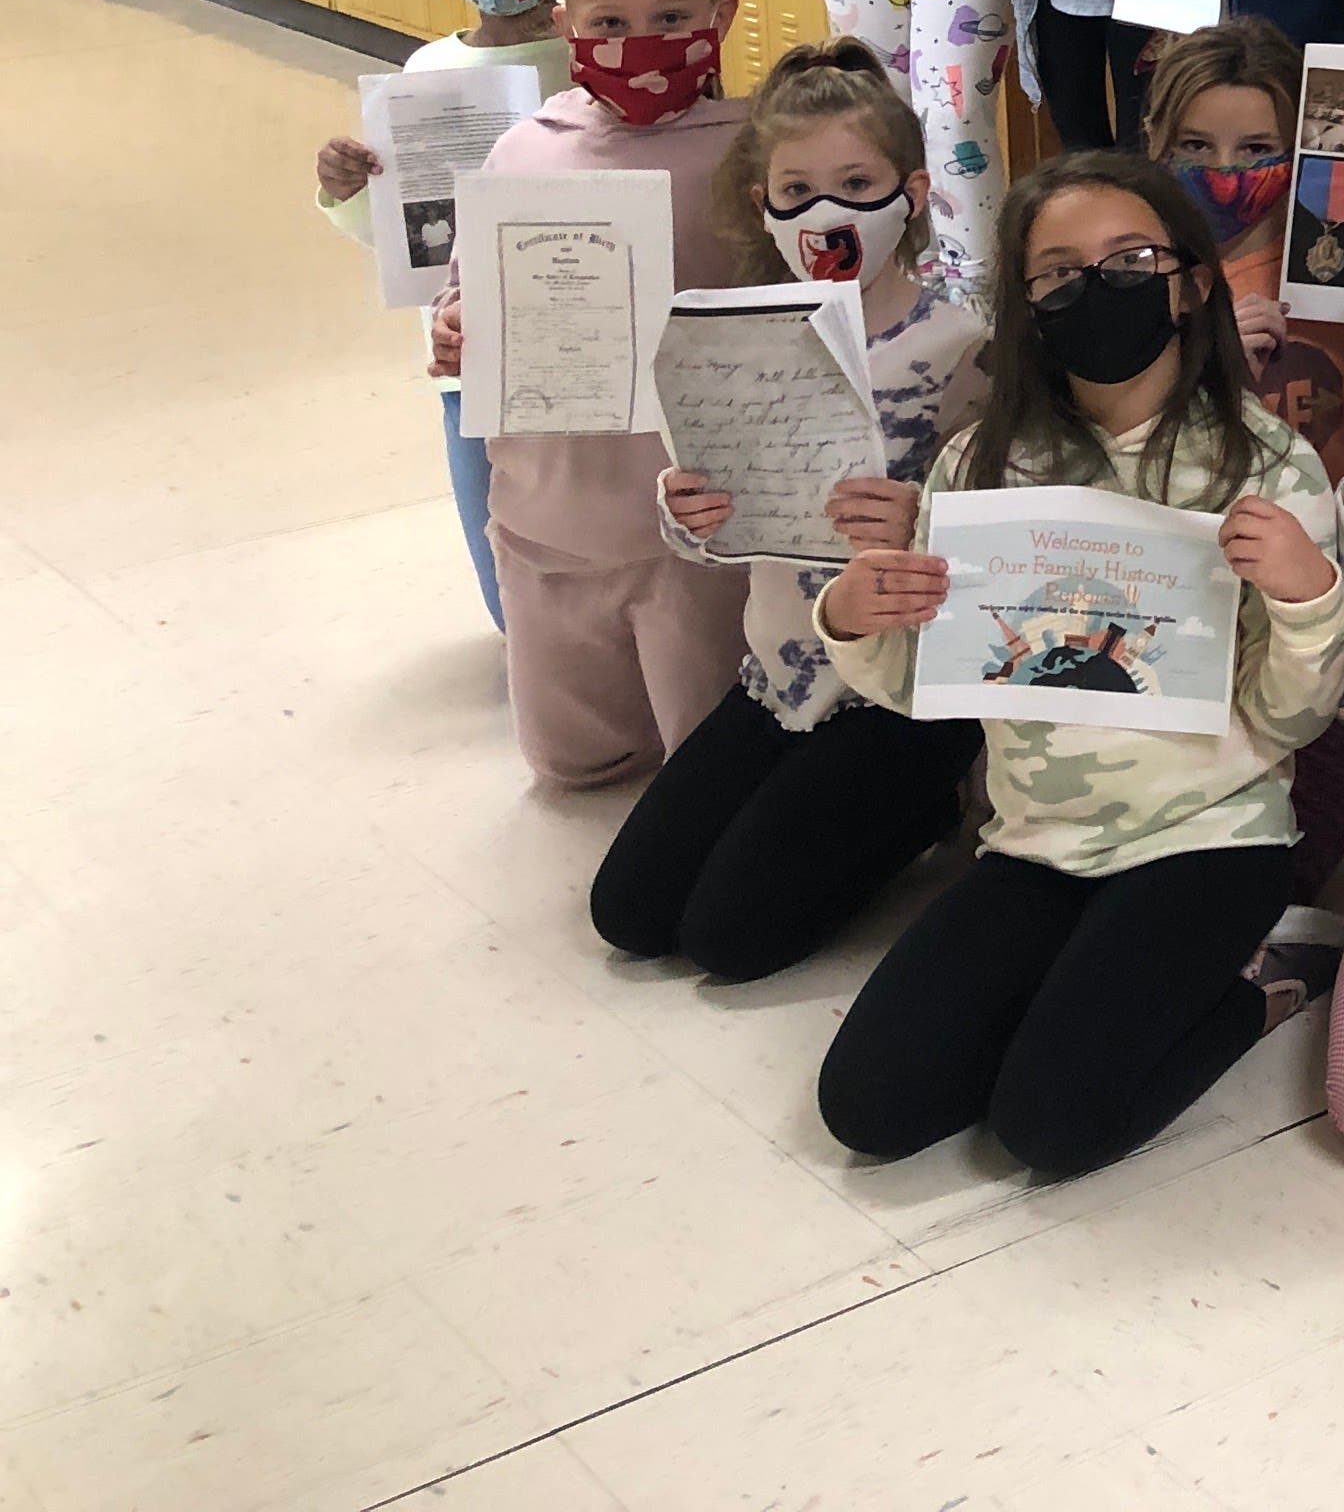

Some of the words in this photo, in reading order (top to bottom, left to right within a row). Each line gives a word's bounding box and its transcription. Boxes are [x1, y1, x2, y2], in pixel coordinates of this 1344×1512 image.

[1029, 530, 1120, 555] Welcome
[1125, 541, 1144, 556] to
[988, 556, 1027, 575] Our
[1033, 556, 1098, 582] Family
[1104, 562, 1178, 588] History
